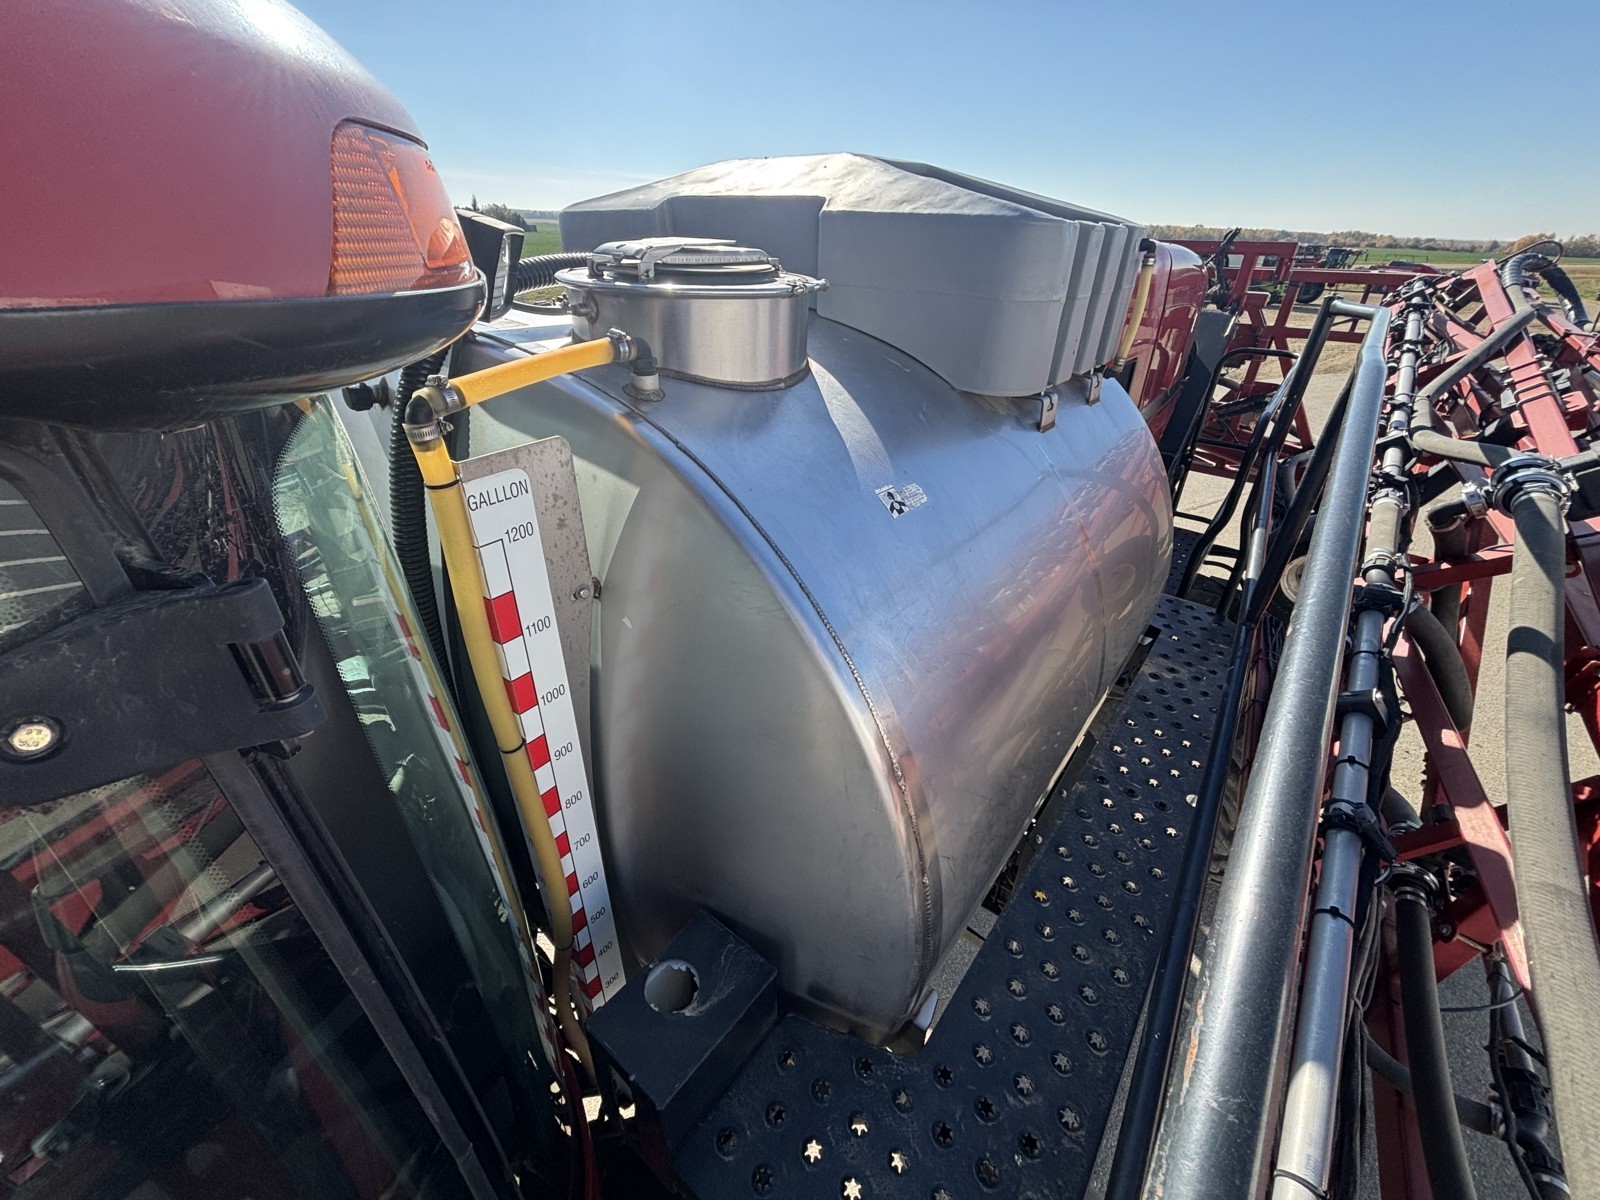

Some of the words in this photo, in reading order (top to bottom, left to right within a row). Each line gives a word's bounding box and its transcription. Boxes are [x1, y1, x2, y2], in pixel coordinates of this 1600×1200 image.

[467, 479, 529, 511] GALLLON
[504, 521, 534, 543] 1200
[525, 615, 551, 637] 1100
[540, 683, 566, 706] 1000
[554, 741, 573, 761] 900
[564, 790, 583, 809] 800
[573, 833, 591, 851] 700
[582, 871, 599, 889] 600
[590, 906, 606, 924] 500
[598, 941, 613, 957] 400
[605, 972, 619, 989] 300
